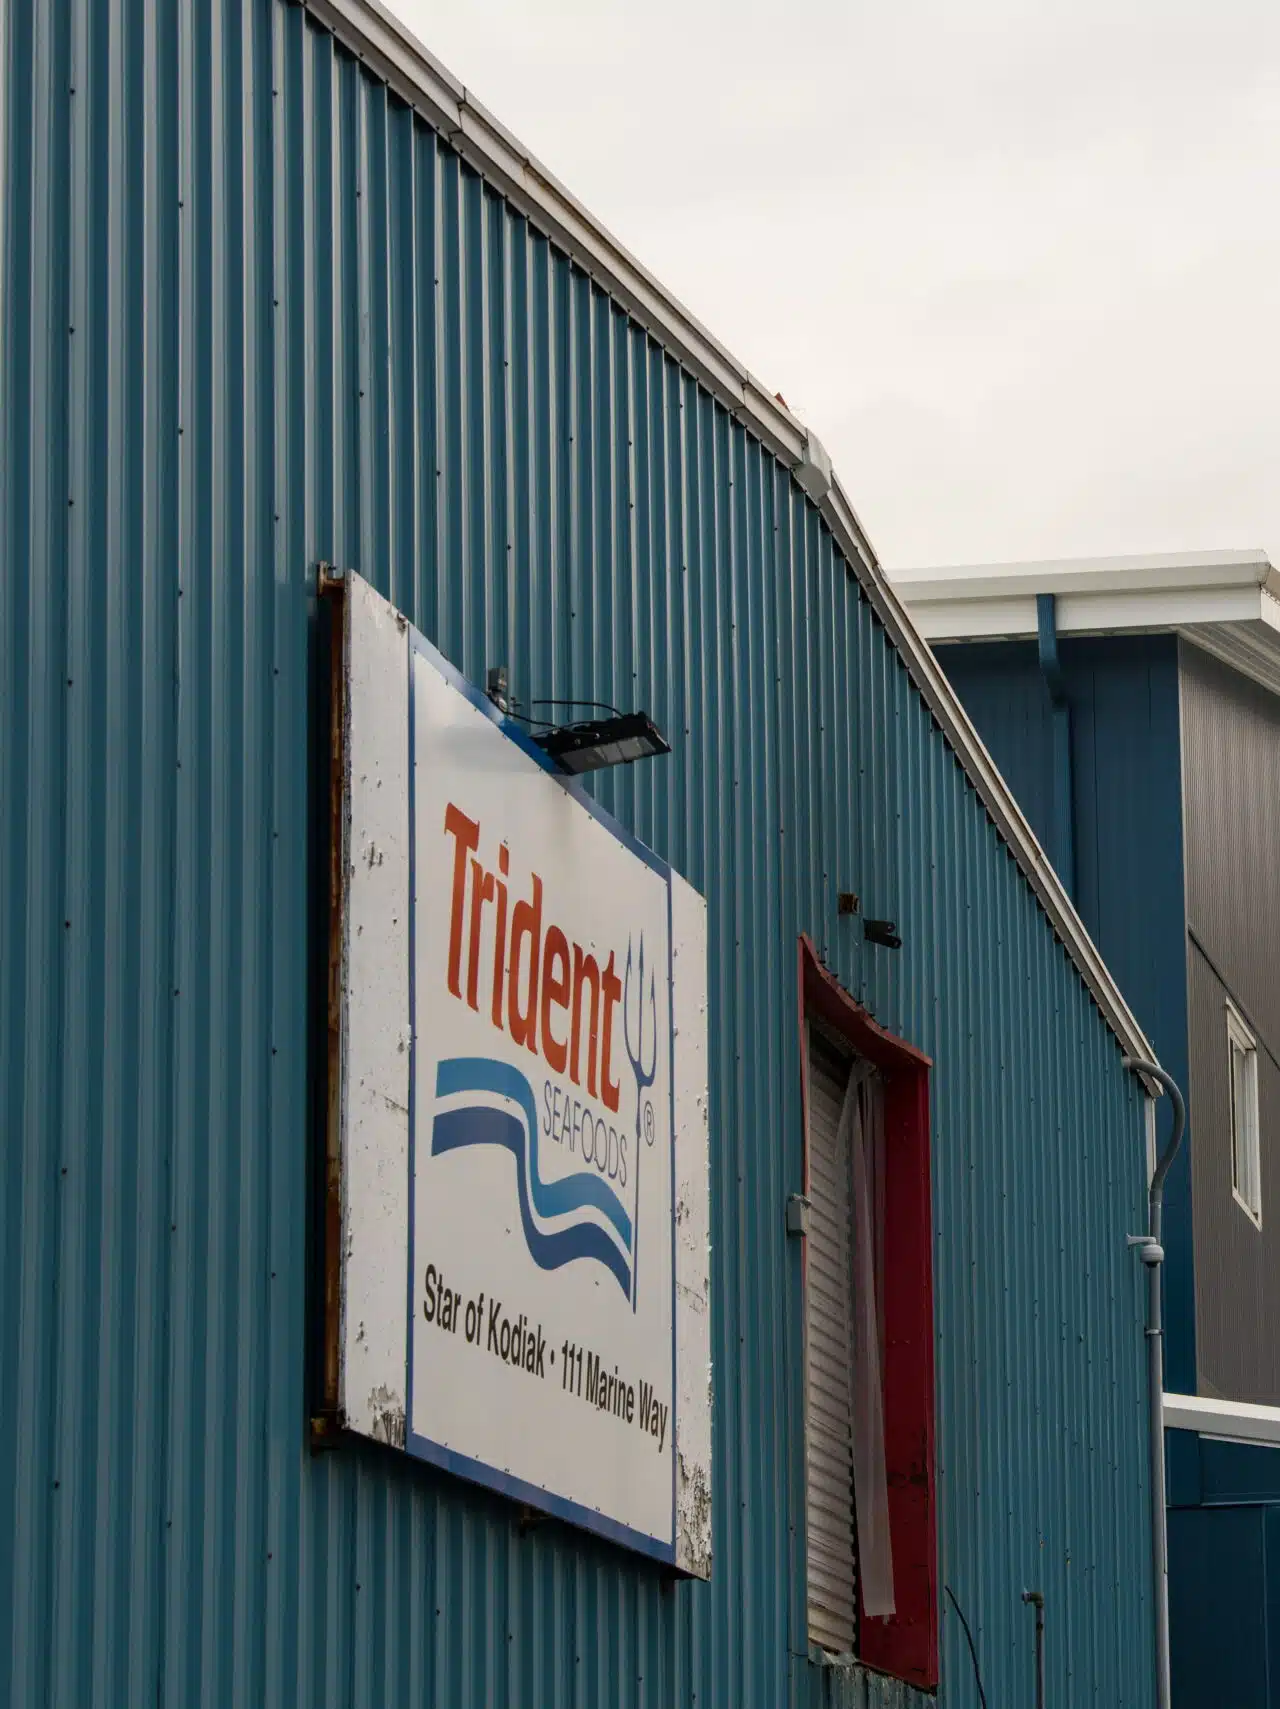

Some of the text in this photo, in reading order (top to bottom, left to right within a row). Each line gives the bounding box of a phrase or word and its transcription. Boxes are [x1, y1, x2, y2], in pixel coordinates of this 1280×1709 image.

[444, 802, 622, 1113] Trident
[543, 1080, 627, 1188] SEAFOODS
[423, 1263, 668, 1453] Star of Kodiak 111 Marine Way
